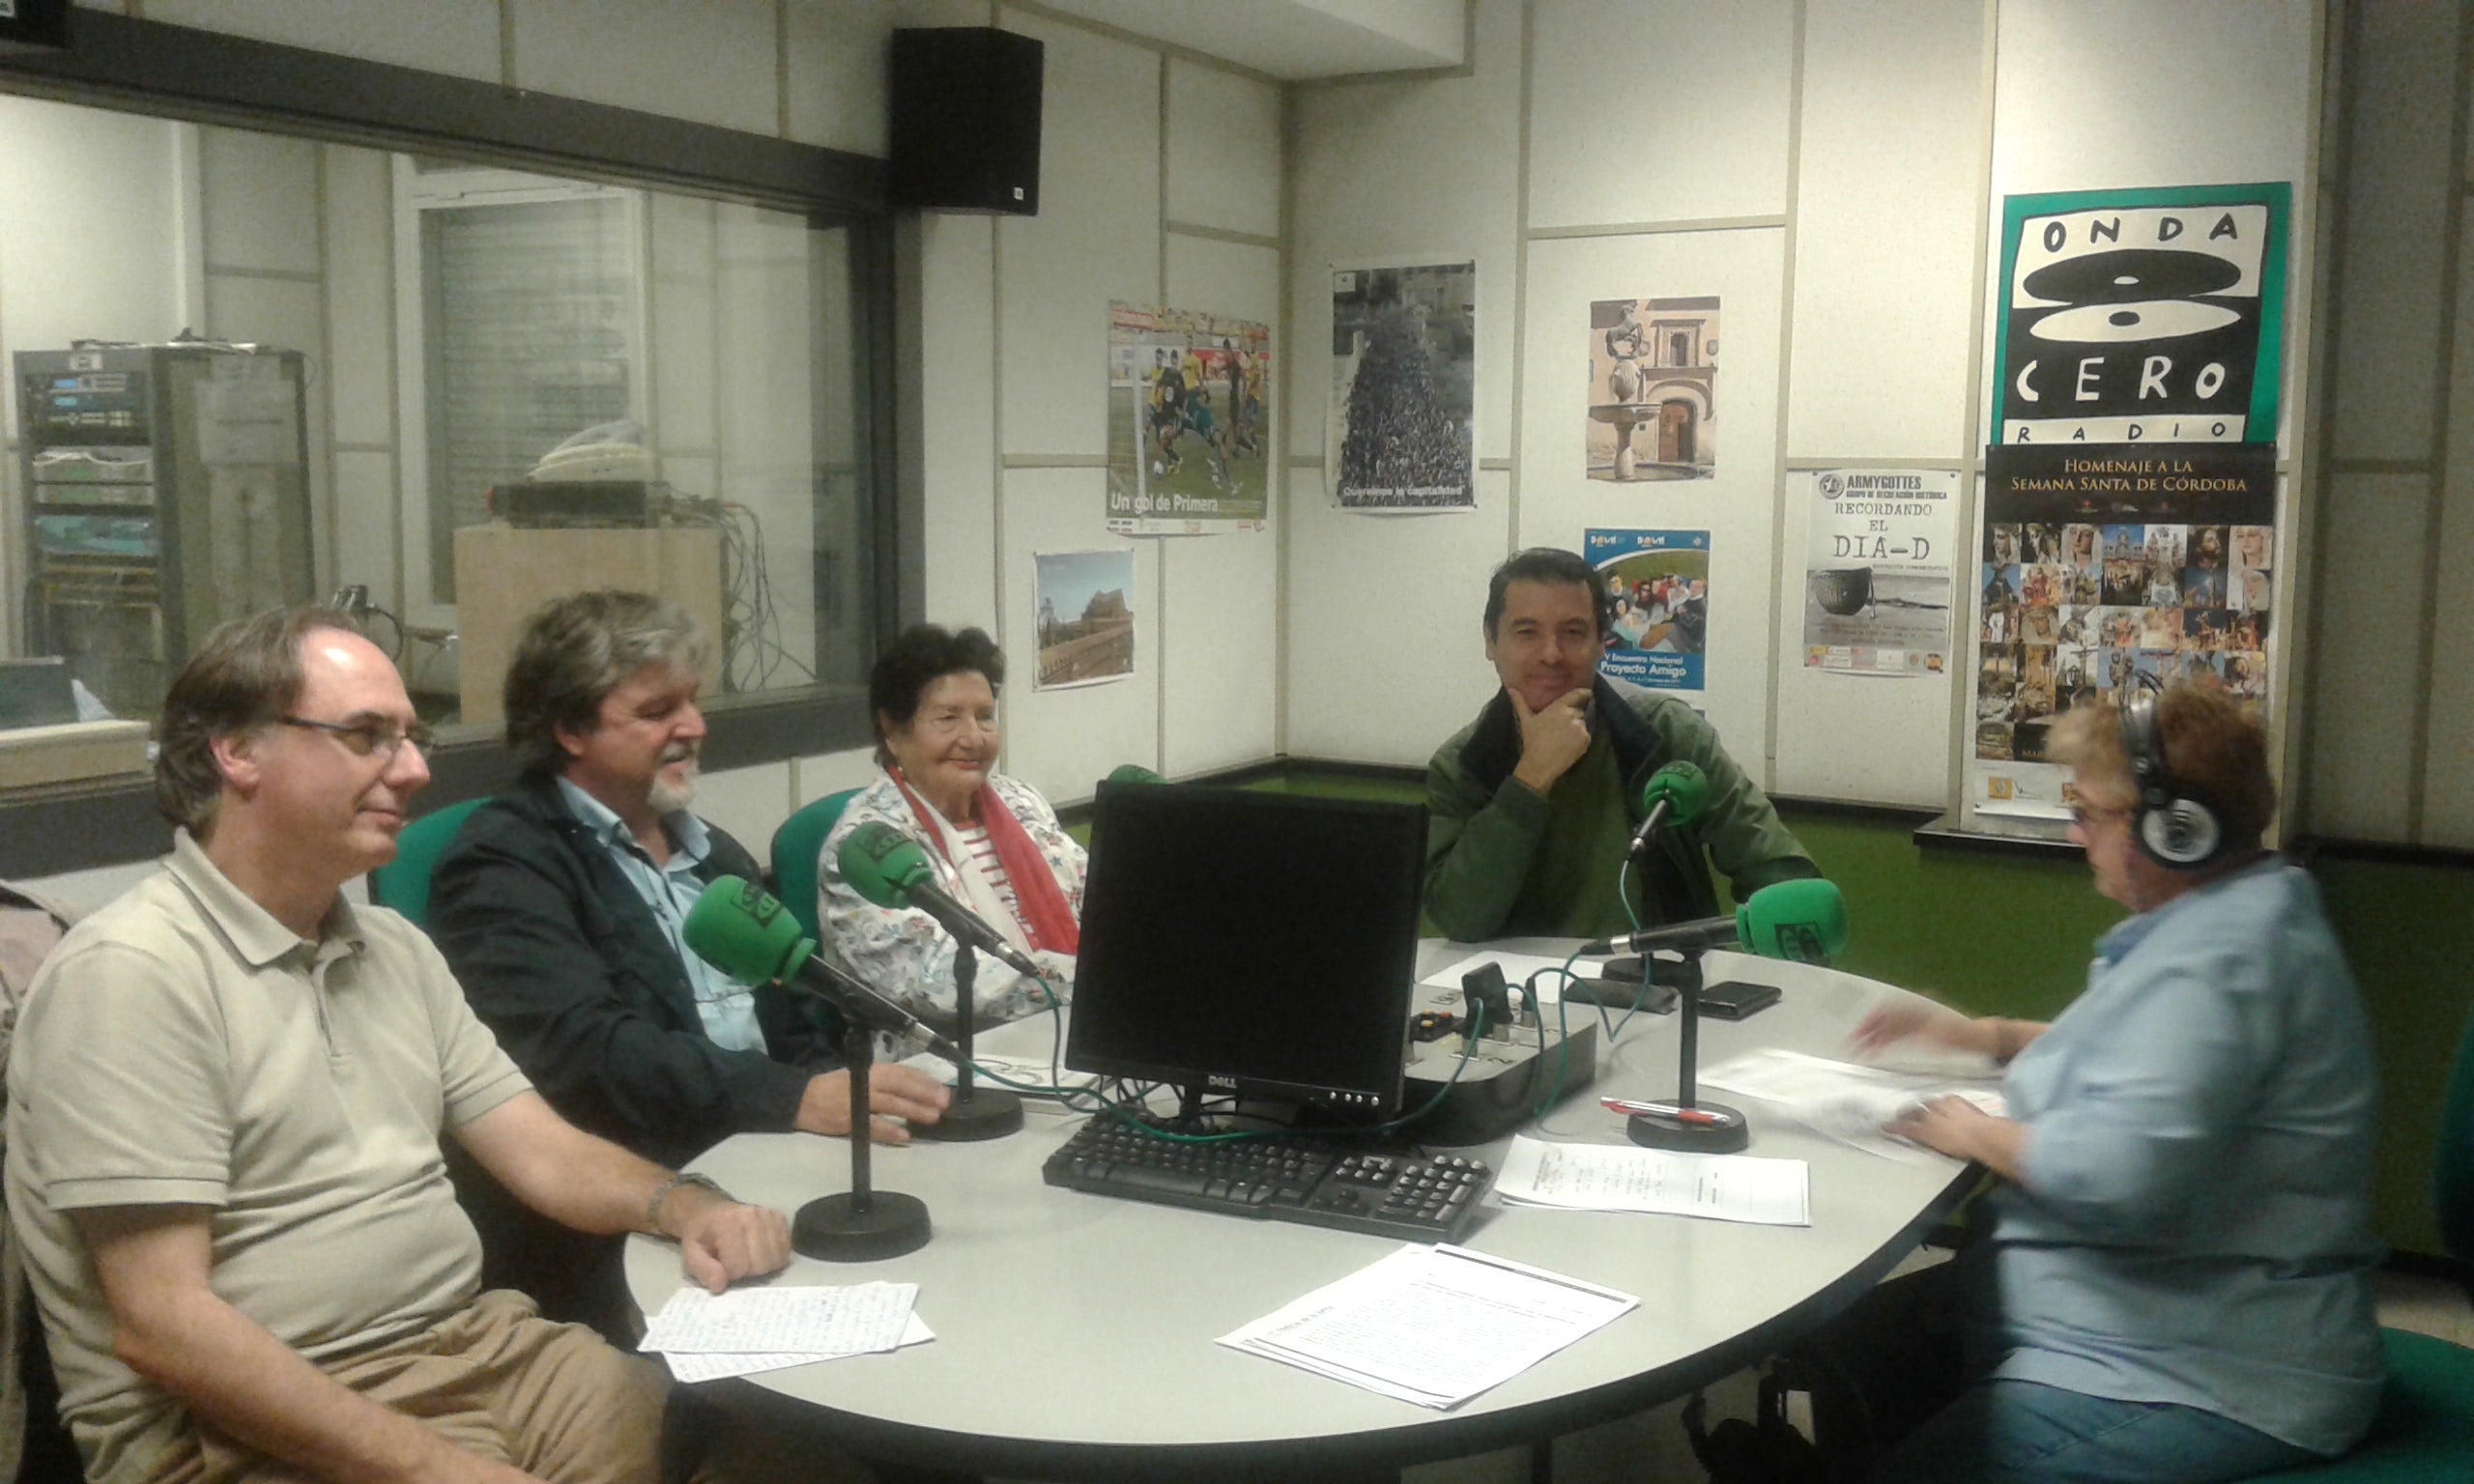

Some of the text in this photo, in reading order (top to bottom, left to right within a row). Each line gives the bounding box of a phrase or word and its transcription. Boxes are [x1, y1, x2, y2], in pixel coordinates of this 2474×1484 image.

[2043, 213, 2238, 253] ONDA
[2016, 355, 2226, 403] CERO
[2017, 421, 2227, 444] RADIO
[2137, 478, 2157, 492] DE
[1111, 493, 1218, 515] Un gol de Primera
[1835, 502, 1932, 516] RECORDANDO
[1869, 520, 1888, 531] EL
[1600, 661, 1687, 678] Proyecto Amigo
[1208, 1074, 1237, 1089] DELL
